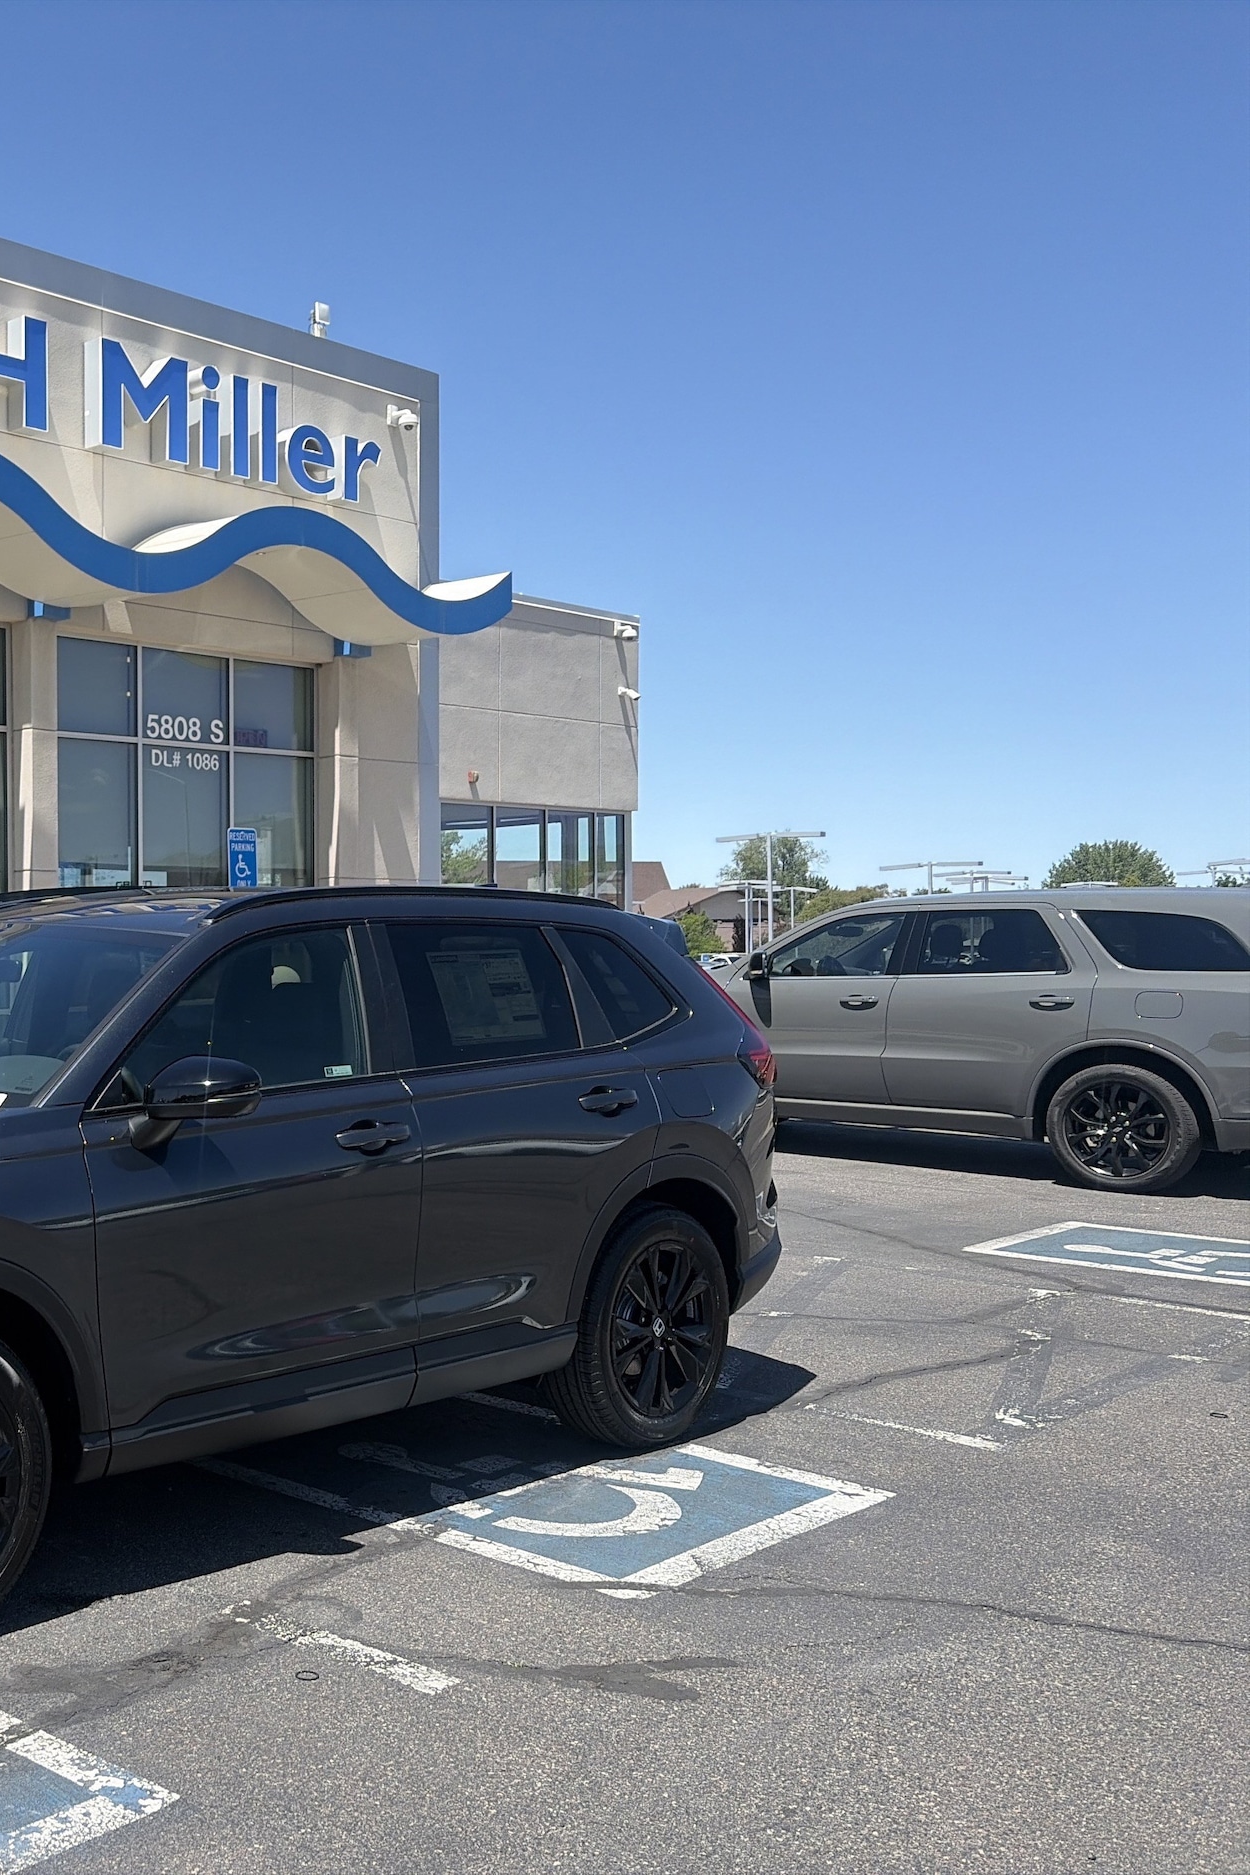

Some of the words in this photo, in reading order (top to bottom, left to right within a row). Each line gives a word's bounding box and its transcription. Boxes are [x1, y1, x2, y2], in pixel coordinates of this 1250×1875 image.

[85, 337, 382, 503] Miller
[146, 713, 202, 741] 5808
[210, 719, 224, 744] S
[151, 749, 181, 768] DL#
[186, 752, 220, 771] 1086
[230, 831, 255, 842] RESERVED
[231, 843, 255, 852] PARKING
